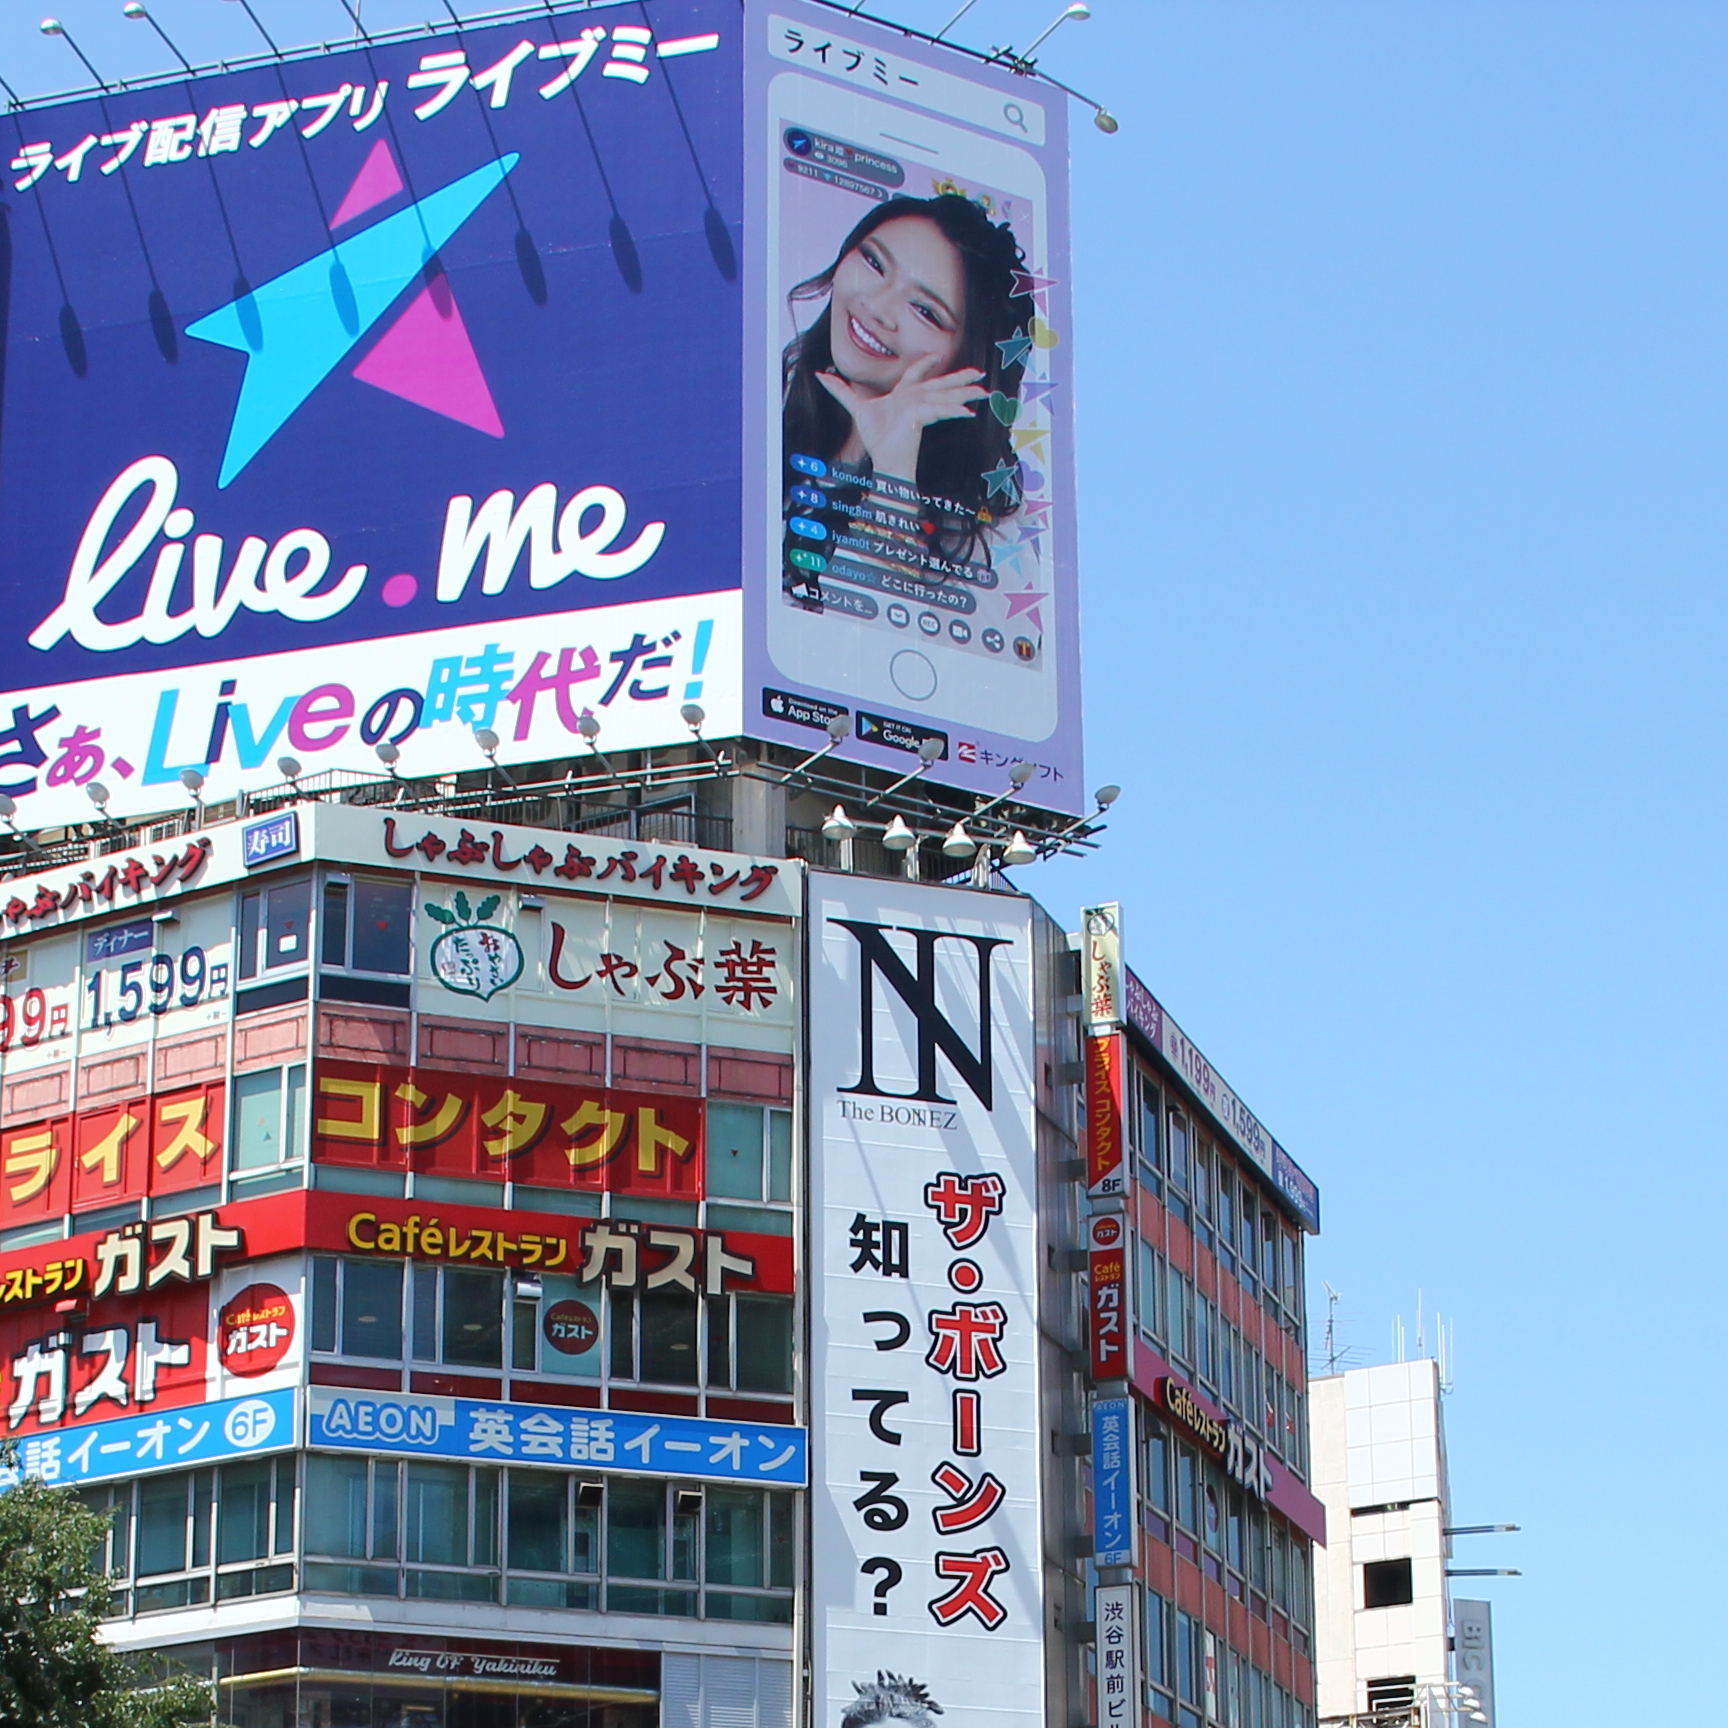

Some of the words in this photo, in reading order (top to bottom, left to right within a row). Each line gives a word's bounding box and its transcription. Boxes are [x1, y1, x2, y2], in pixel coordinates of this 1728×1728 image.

[784, 29, 919, 86] ライブミー
[11, 81, 388, 193] ライブ配信アプリ
[405, 25, 719, 121] ライブミー
[788, 704, 811, 722] App
[883, 728, 920, 748] Google
[246, 821, 293, 859] 寿司
[383, 818, 778, 901] しゃぶしゃぶバイキング
[87, 944, 228, 1029] 1,599円
[550, 921, 777, 1011] しゃぶ葉
[1090, 941, 1113, 1018] しゃぶ葉
[317, 1076, 690, 1172] コンタクト
[837, 1100, 874, 1122] The
[1101, 1177, 1121, 1193] 8F
[94, 1212, 241, 1297] ガスト
[580, 1222, 754, 1295] ガスト
[1094, 1262, 1120, 1275] Café
[226, 1324, 288, 1356] ガスト
[551, 1322, 594, 1339] ガスト
[1096, 1284, 1120, 1362] ガスト
[9, 1322, 190, 1429] ガスト
[924, 1171, 1010, 1631] ザ・ボーンズ
[329, 1401, 437, 1440] AEON
[468, 1408, 796, 1472] 英会話イーオン
[848, 1214, 910, 1616] 知ってる?
[1100, 1415, 1122, 1552] 英会話イーオン
[1227, 1422, 1273, 1500] ガスト
[388, 1649, 431, 1672] King
